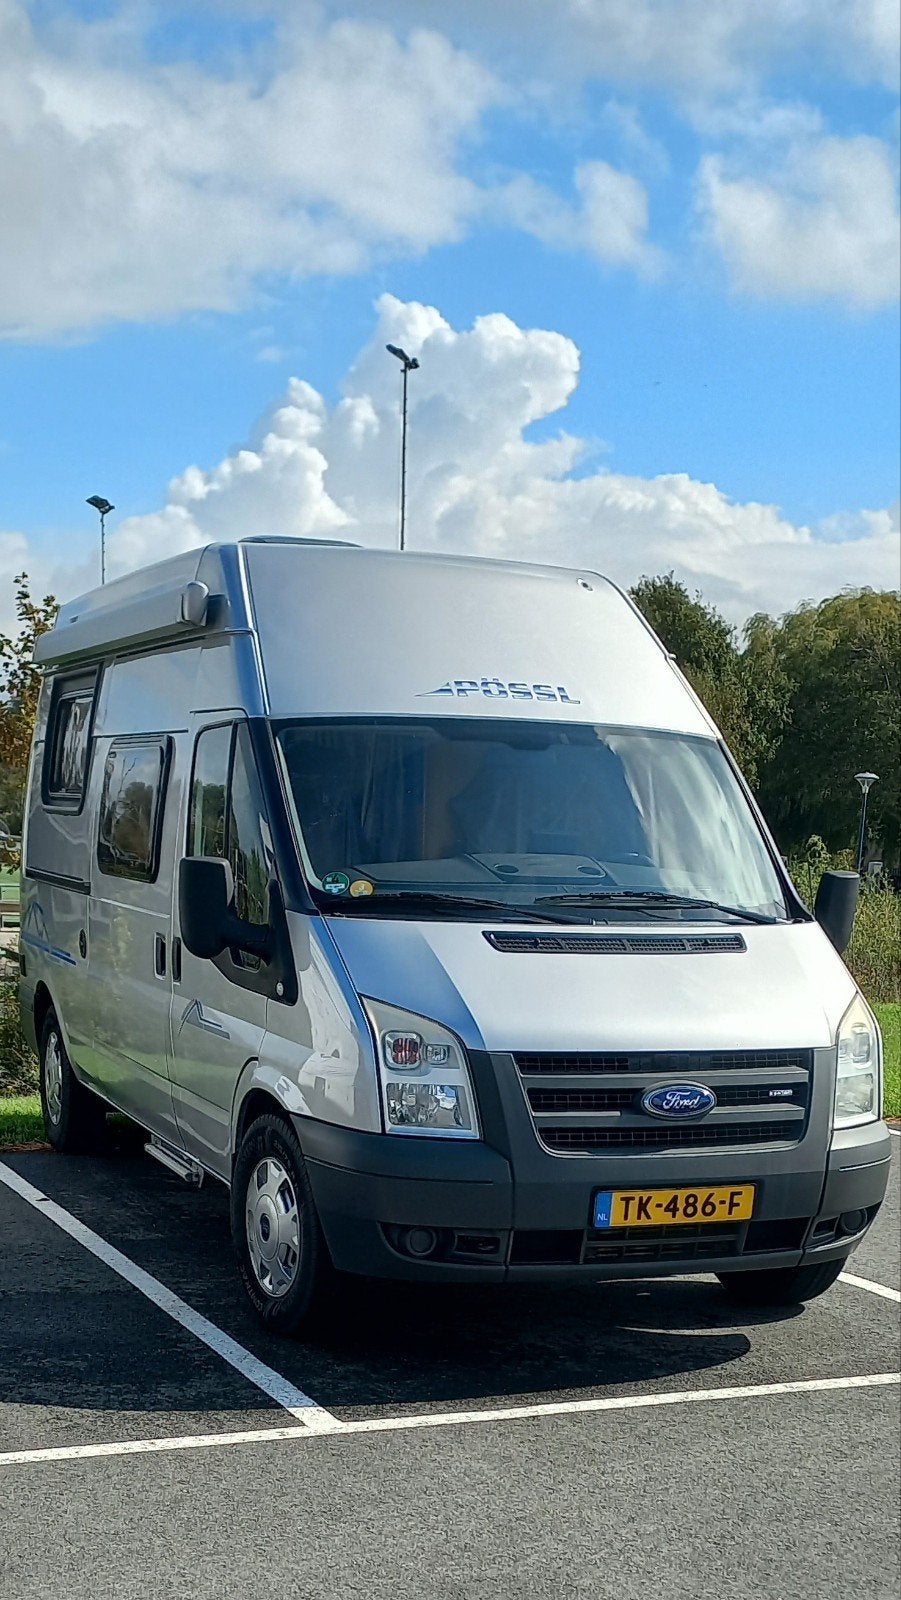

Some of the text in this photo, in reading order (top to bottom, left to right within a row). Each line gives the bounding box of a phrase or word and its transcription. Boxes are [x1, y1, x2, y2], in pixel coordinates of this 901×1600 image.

[453, 677, 581, 705] PÖSSL
[662, 1091, 701, 1110] Ford
[597, 1213, 609, 1221] NL
[619, 1190, 743, 1222] TK-486-F
